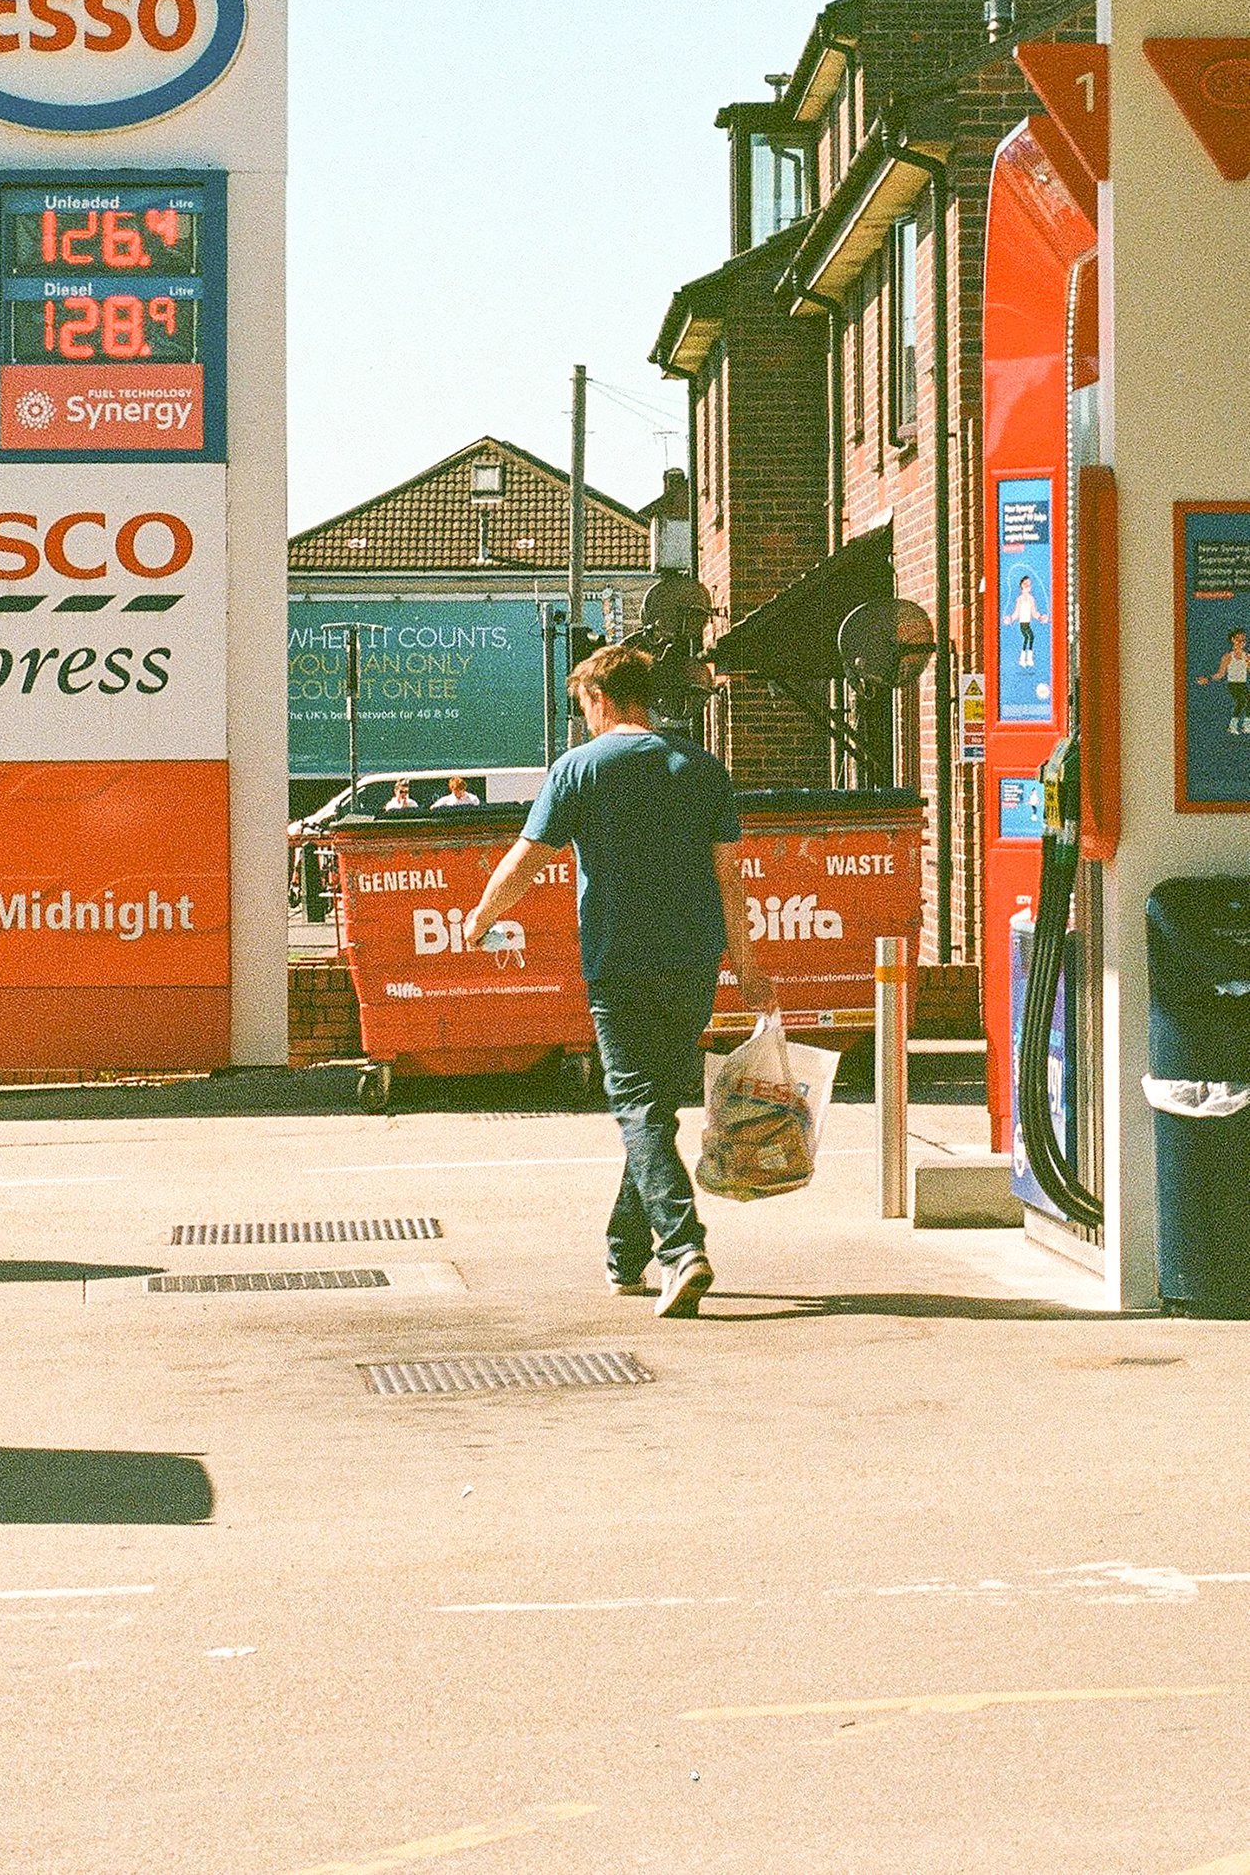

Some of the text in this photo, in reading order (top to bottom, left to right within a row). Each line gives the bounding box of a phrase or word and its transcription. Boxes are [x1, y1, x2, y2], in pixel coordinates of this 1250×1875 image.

[1075, 71, 1096, 113] 1
[44, 195, 121, 210] Unleaded
[169, 198, 194, 209] Litre
[44, 282, 93, 297] Diesel
[169, 286, 194, 296] Litre
[44, 295, 177, 359] 128.9
[87, 388, 193, 399] FUEL TECHNOLOGY
[65, 396, 193, 430] Synergy
[368, 625, 394, 649] IT
[398, 626, 512, 650] COUNTS,
[288, 652, 475, 675] YOU AN ONLY
[382, 678, 422, 700] ON
[428, 677, 460, 700] EE
[288, 711, 303, 721] he
[825, 853, 895, 876] WASTE
[358, 863, 570, 893] GENERAL STE
[412, 907, 527, 956] Bia
[718, 969, 739, 987] ffa
[385, 981, 424, 999] Biffa
